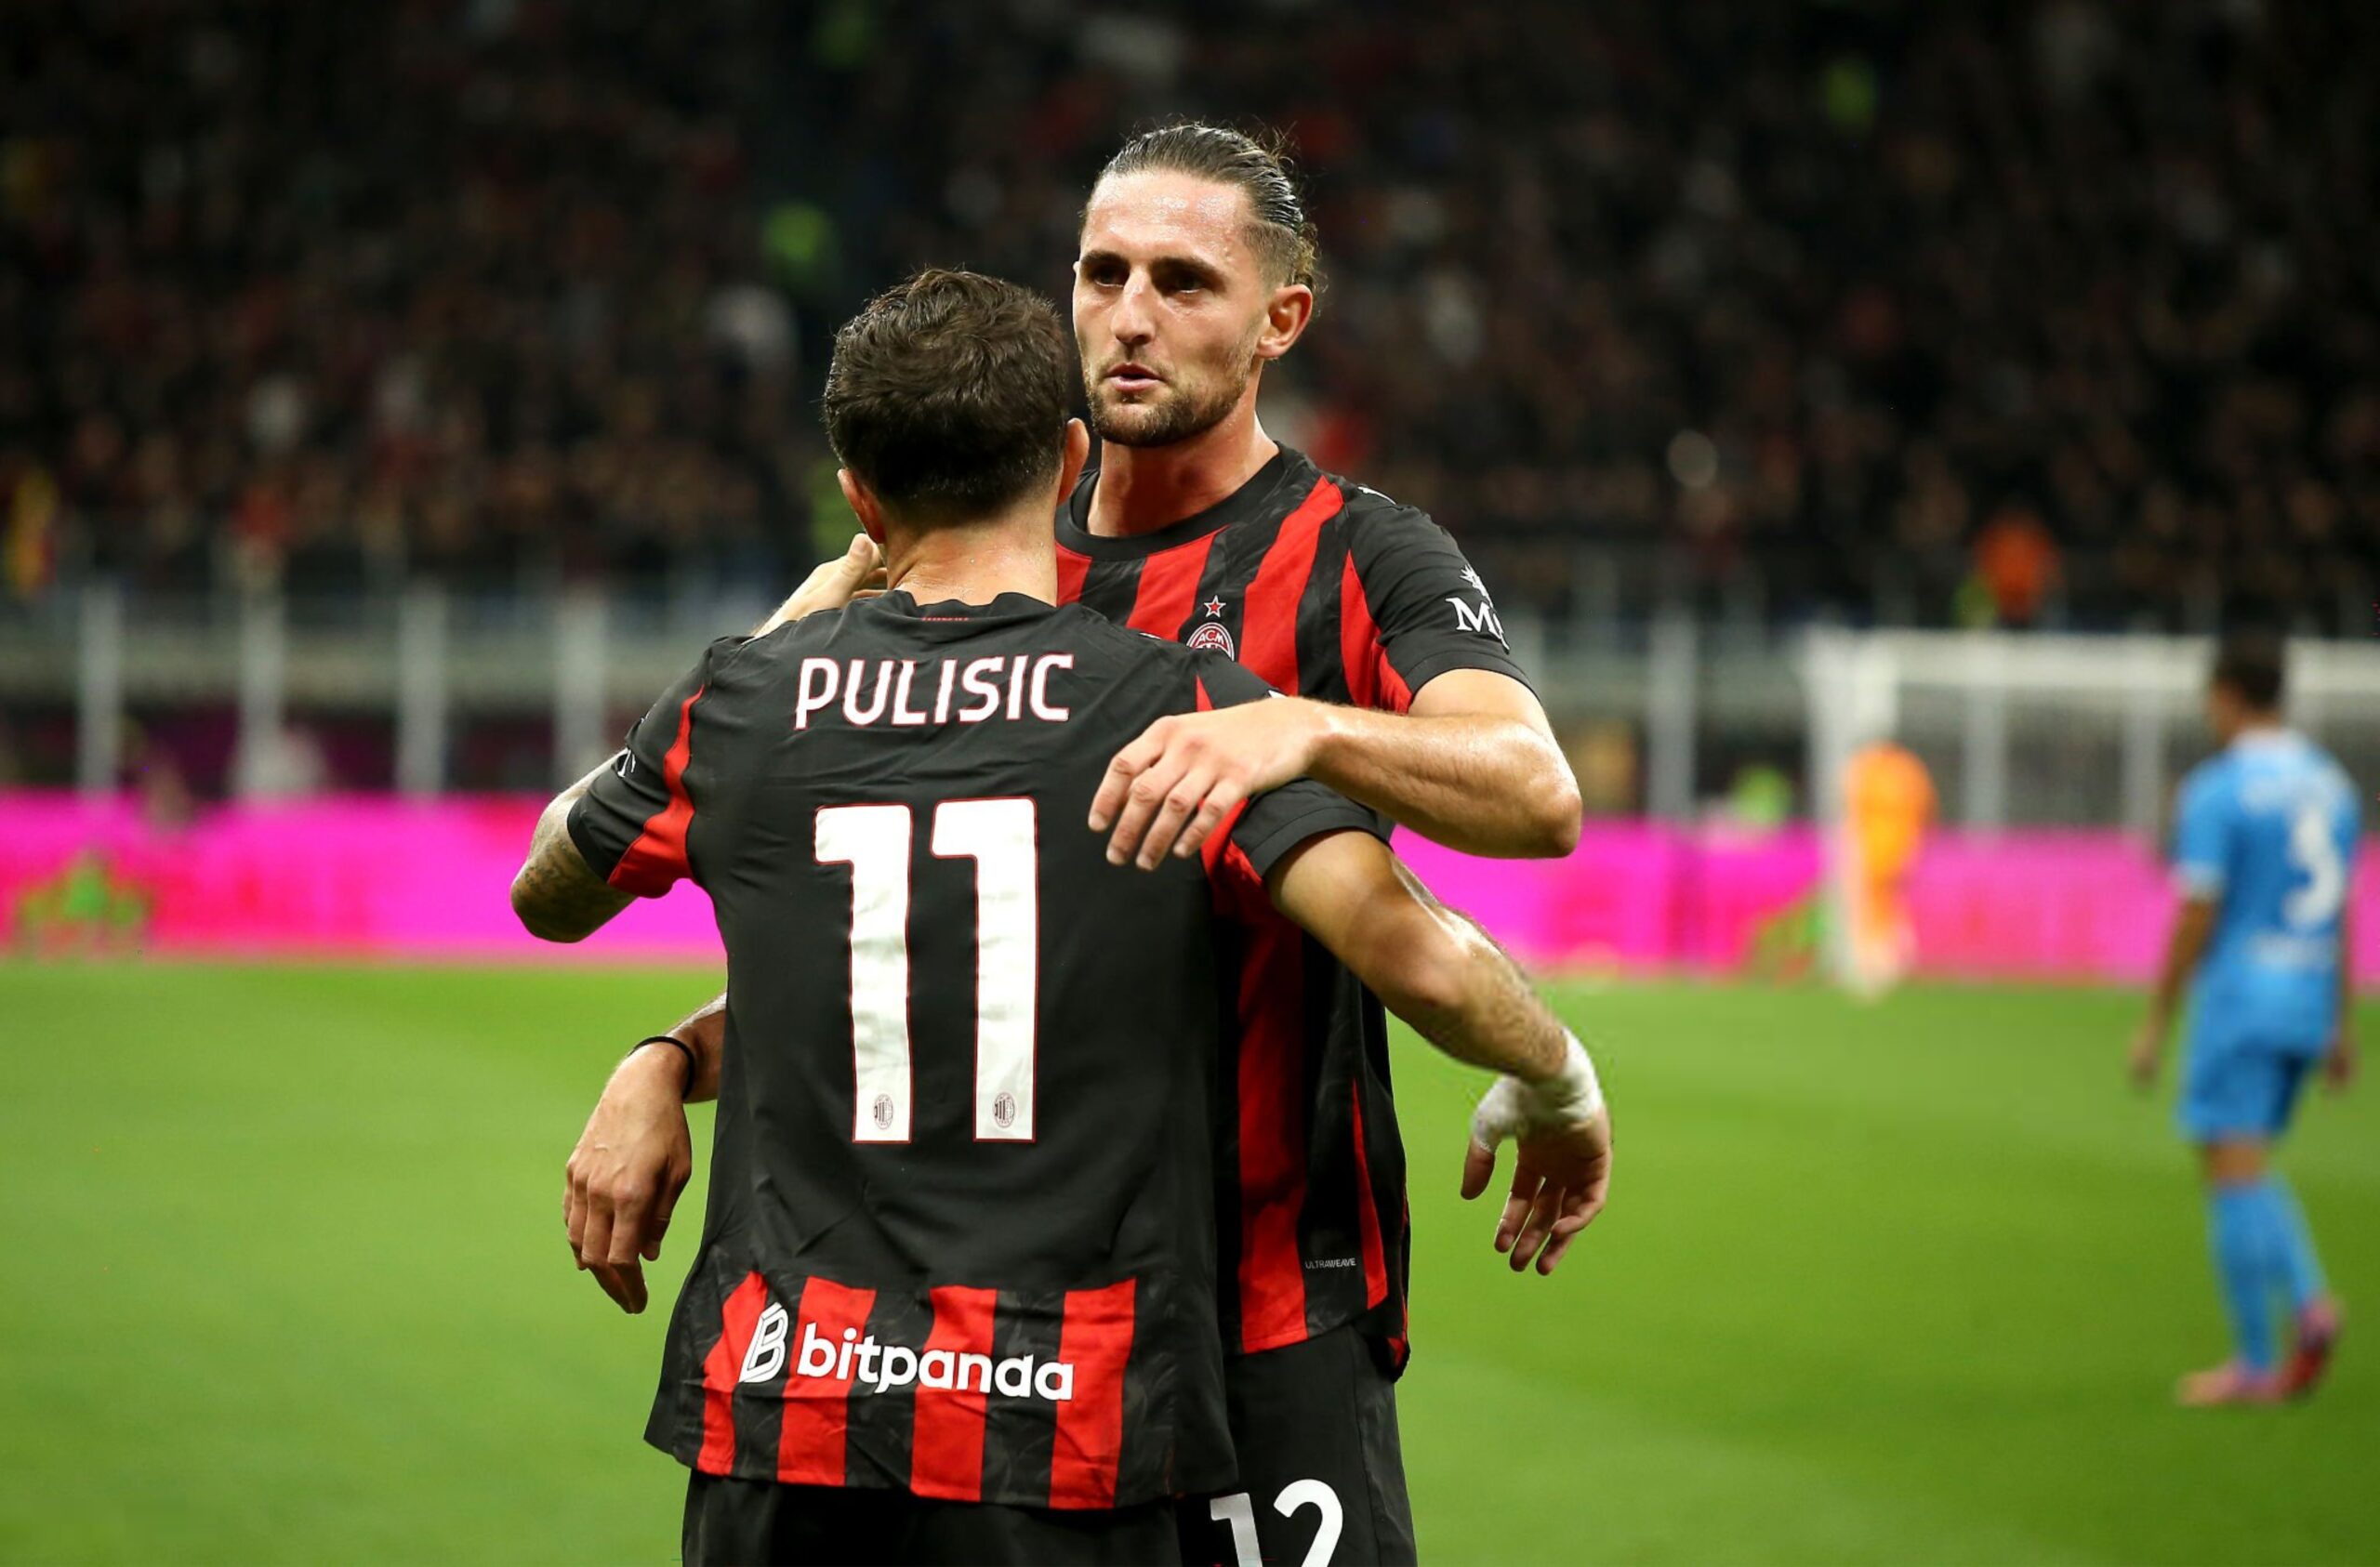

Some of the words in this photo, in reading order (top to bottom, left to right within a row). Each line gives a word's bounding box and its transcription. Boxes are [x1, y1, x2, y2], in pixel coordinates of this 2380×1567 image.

[1196, 629, 1225, 648] ACM
[795, 653, 1074, 731] PULISIC
[813, 797, 1038, 1143] 11
[1304, 1258, 1356, 1270] ULTRAWEAVE
[797, 1323, 1074, 1401] bitpanda
[1210, 1479, 1343, 1567] 12
